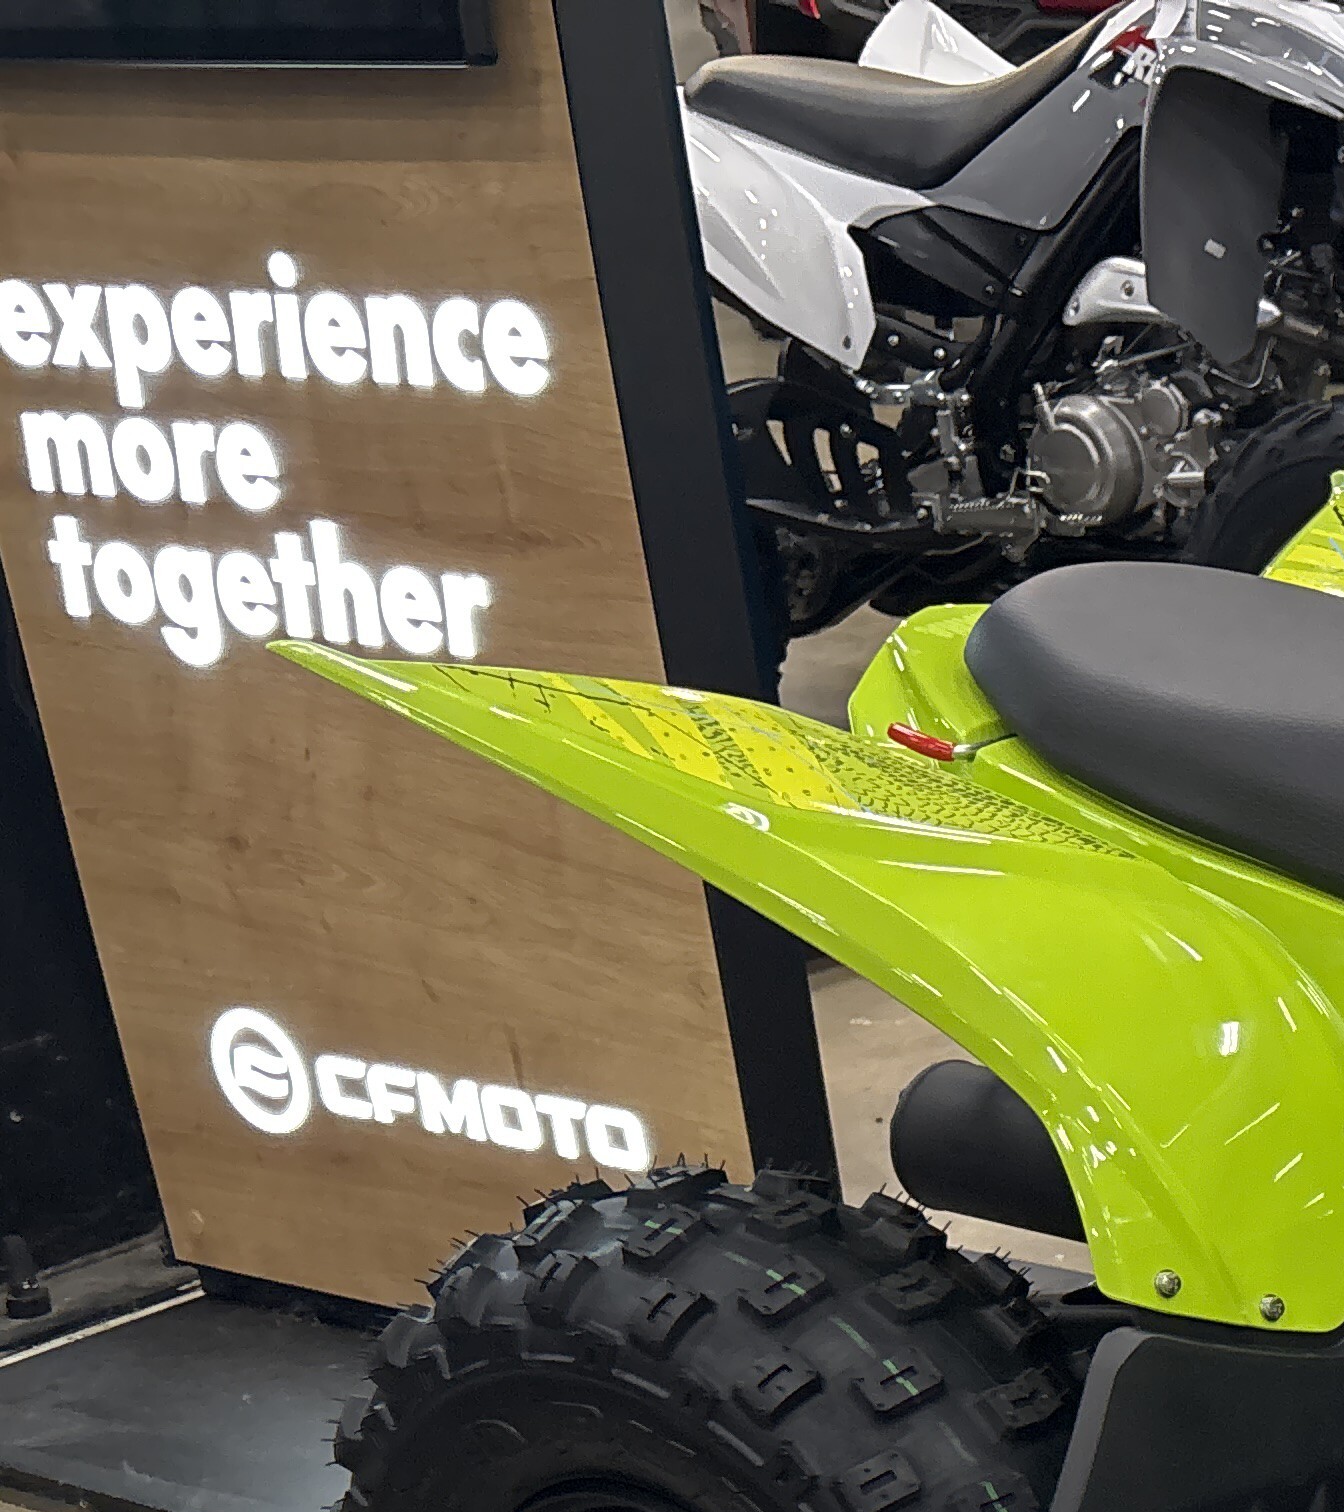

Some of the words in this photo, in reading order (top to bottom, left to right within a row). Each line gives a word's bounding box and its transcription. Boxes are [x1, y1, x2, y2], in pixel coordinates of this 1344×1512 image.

[0, 251, 549, 408] experience
[20, 411, 282, 512] more
[48, 515, 492, 668] together
[314, 1054, 651, 1172] CFMOTO
